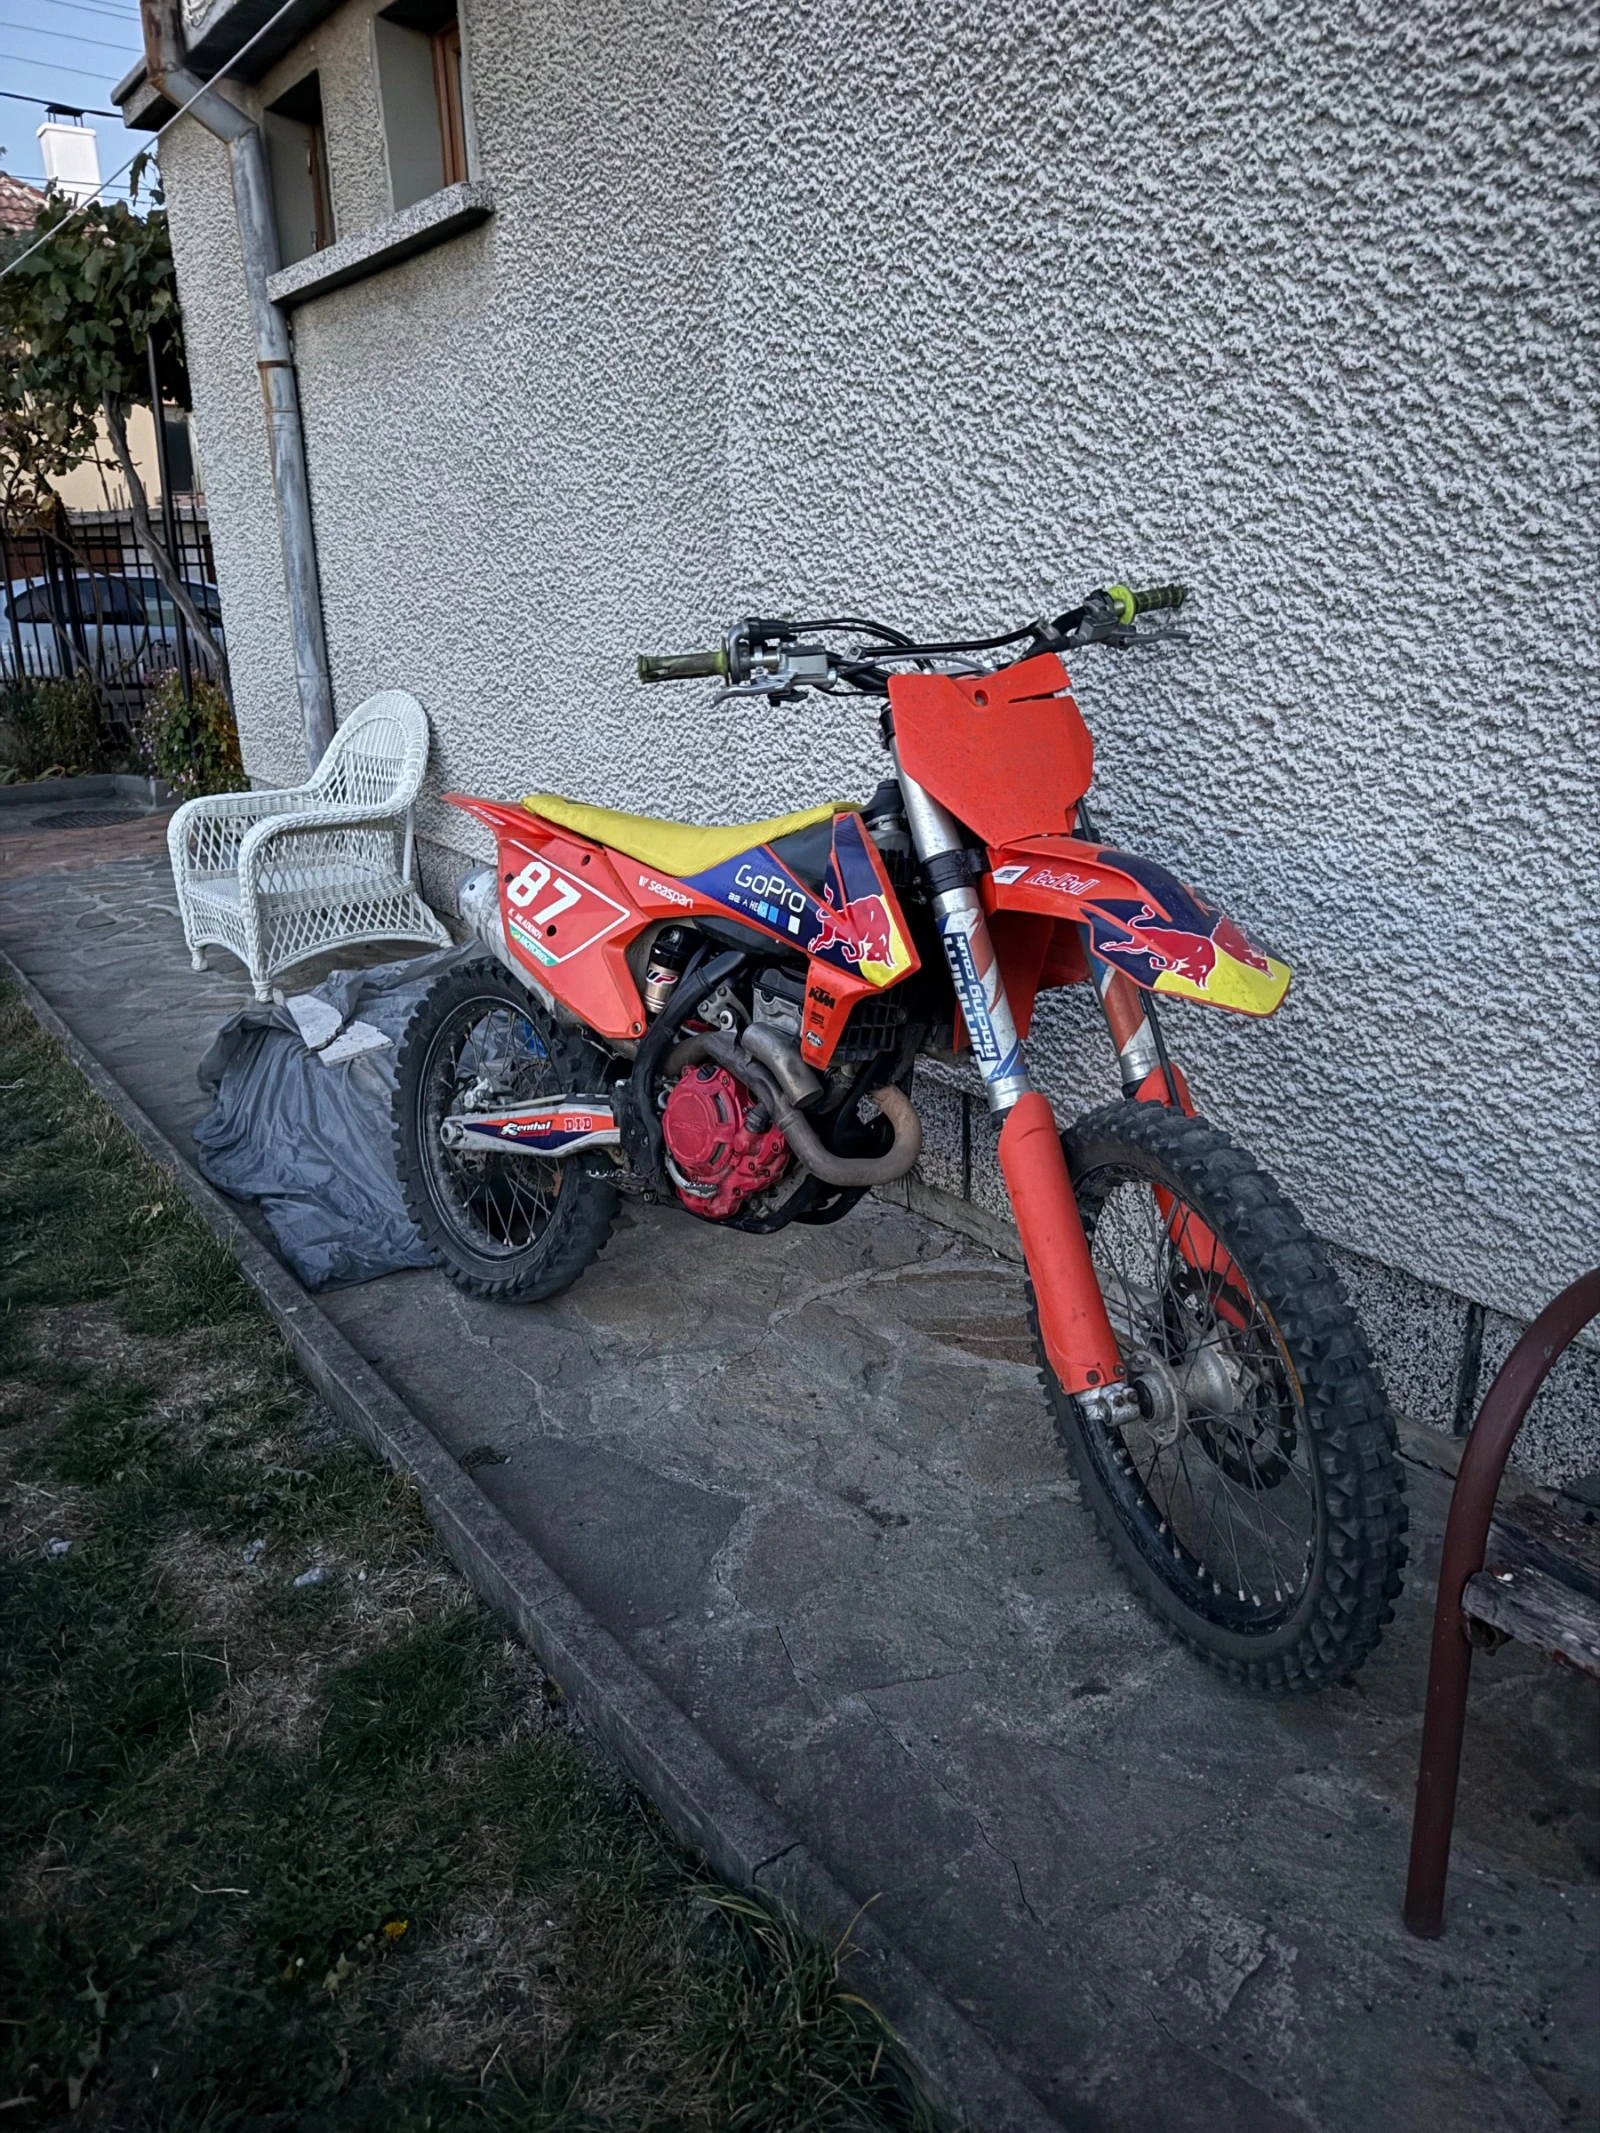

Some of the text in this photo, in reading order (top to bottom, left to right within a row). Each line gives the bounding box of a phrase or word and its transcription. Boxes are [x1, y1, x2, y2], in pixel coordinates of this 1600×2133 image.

[506, 861, 582, 925] 87
[648, 880, 694, 909] seaspan
[734, 864, 807, 913] GoPro
[808, 986, 836, 1010] KTM
[500, 1120, 553, 1136] Renthal
